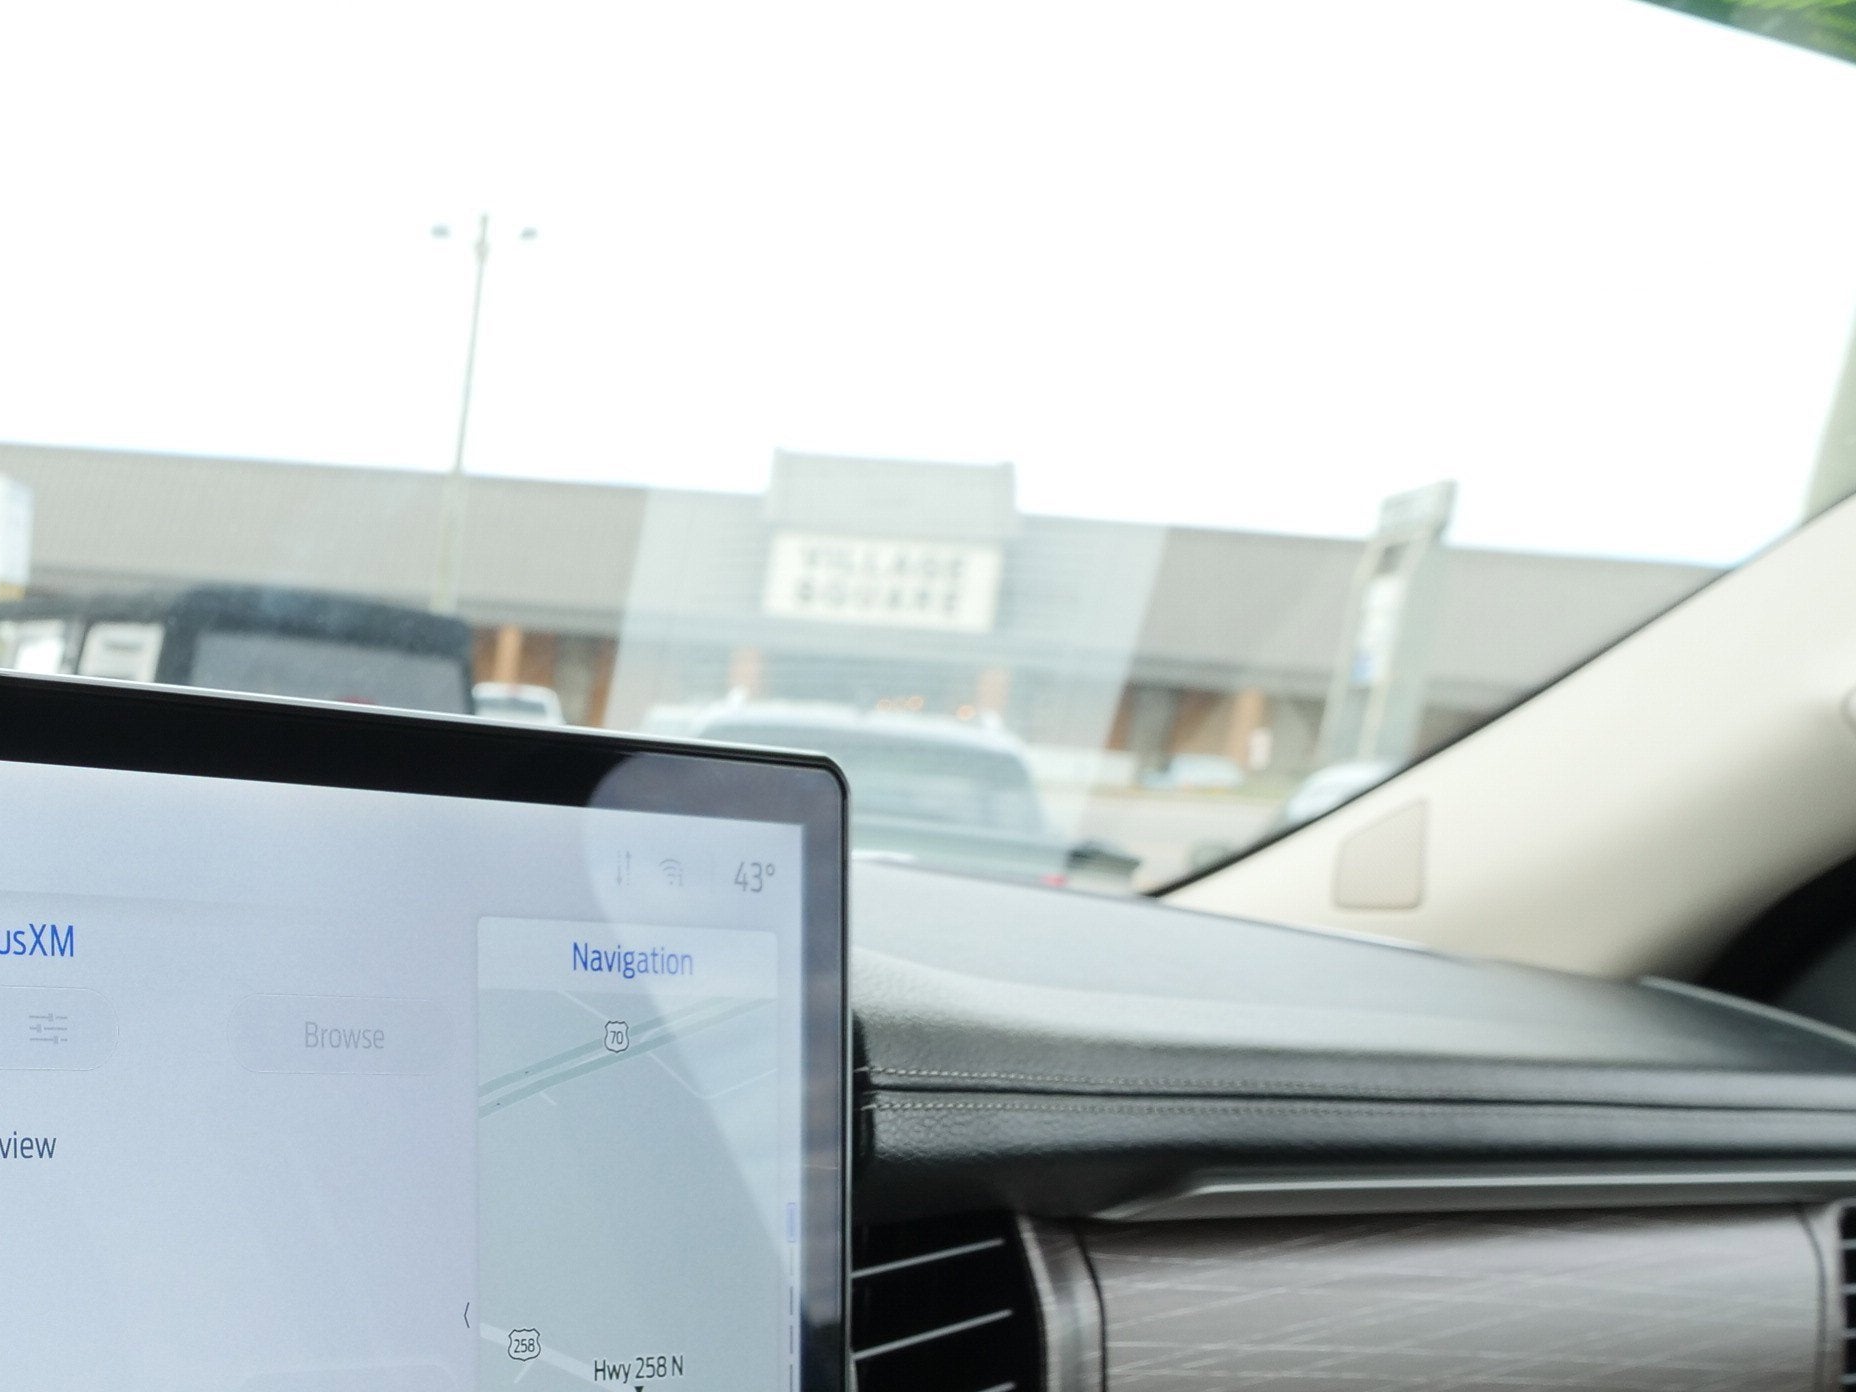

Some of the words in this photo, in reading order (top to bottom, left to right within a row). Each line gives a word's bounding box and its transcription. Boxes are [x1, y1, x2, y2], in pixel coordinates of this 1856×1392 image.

[572, 942, 694, 978] Navigation
[304, 1021, 386, 1051] Browse
[609, 1029, 625, 1046] 70
[513, 1337, 535, 1354] 258
[593, 1357, 631, 1384] Hwy
[634, 1356, 667, 1380] 258
[670, 1355, 685, 1377] N
